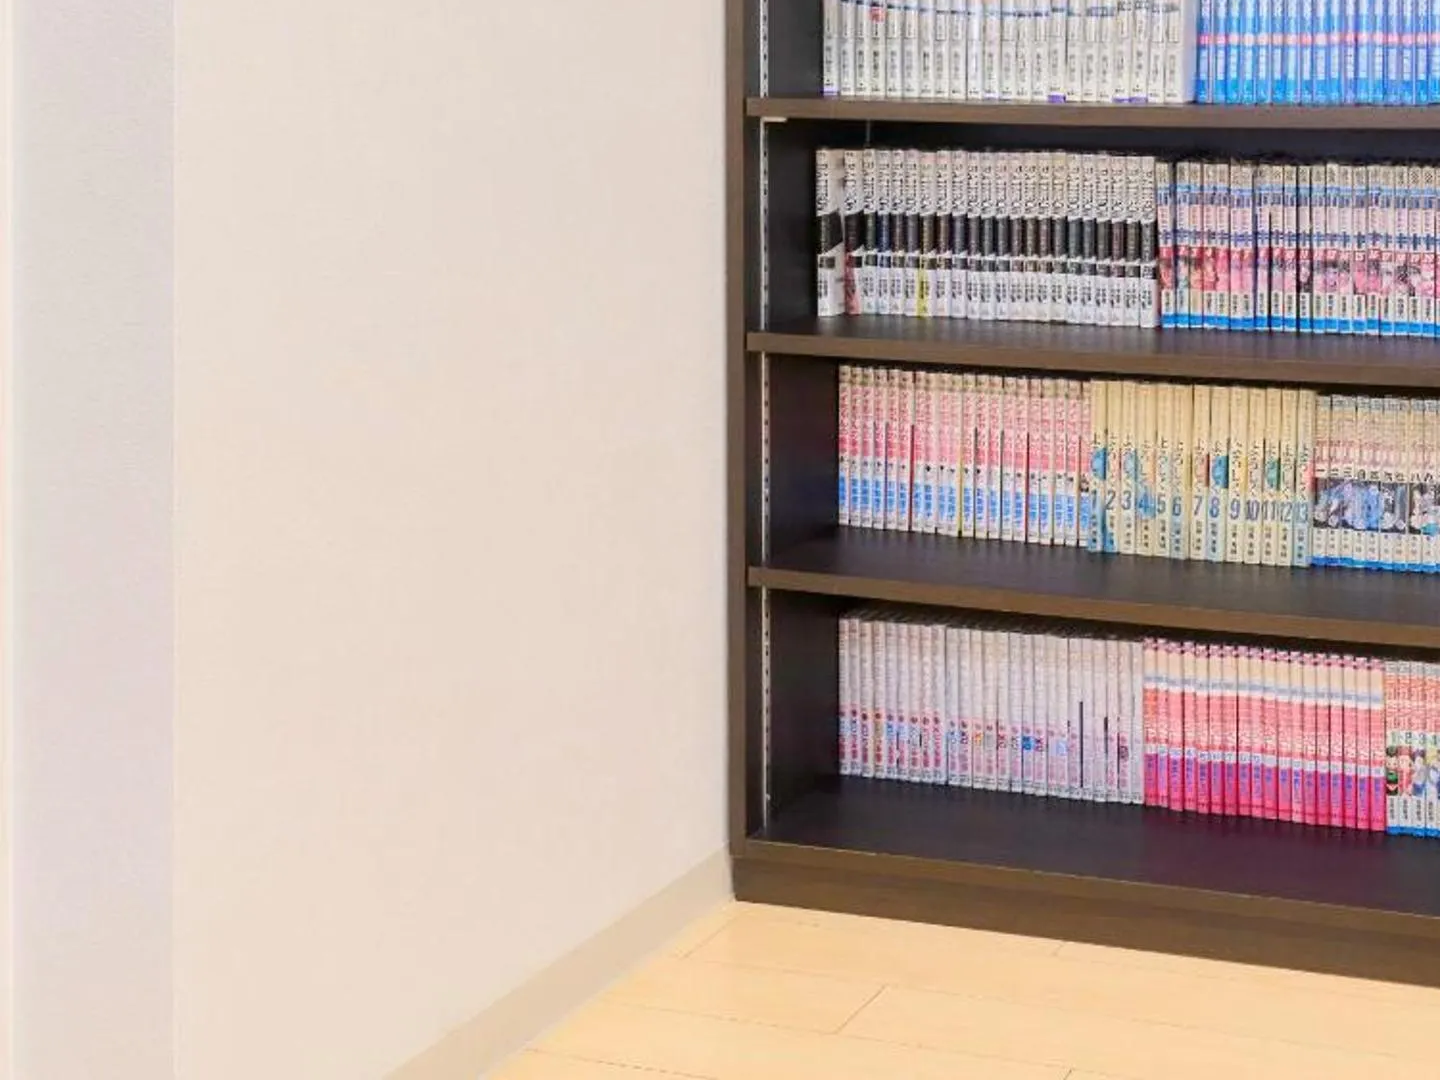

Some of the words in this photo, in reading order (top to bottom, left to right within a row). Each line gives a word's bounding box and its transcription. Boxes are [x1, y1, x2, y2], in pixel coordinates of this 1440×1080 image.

[1106, 491, 1115, 510] 2
[1123, 491, 1131, 510] 3
[1139, 492, 1149, 510] 4
[1157, 494, 1165, 513] 5
[1173, 496, 1181, 516] 6
[1194, 496, 1203, 515] 7
[1210, 497, 1219, 518] 8
[1231, 498, 1240, 519] 9
[1245, 500, 1260, 520] 10
[1262, 500, 1277, 520] 11
[1280, 502, 1292, 522] 12
[1295, 502, 1308, 521] 13
